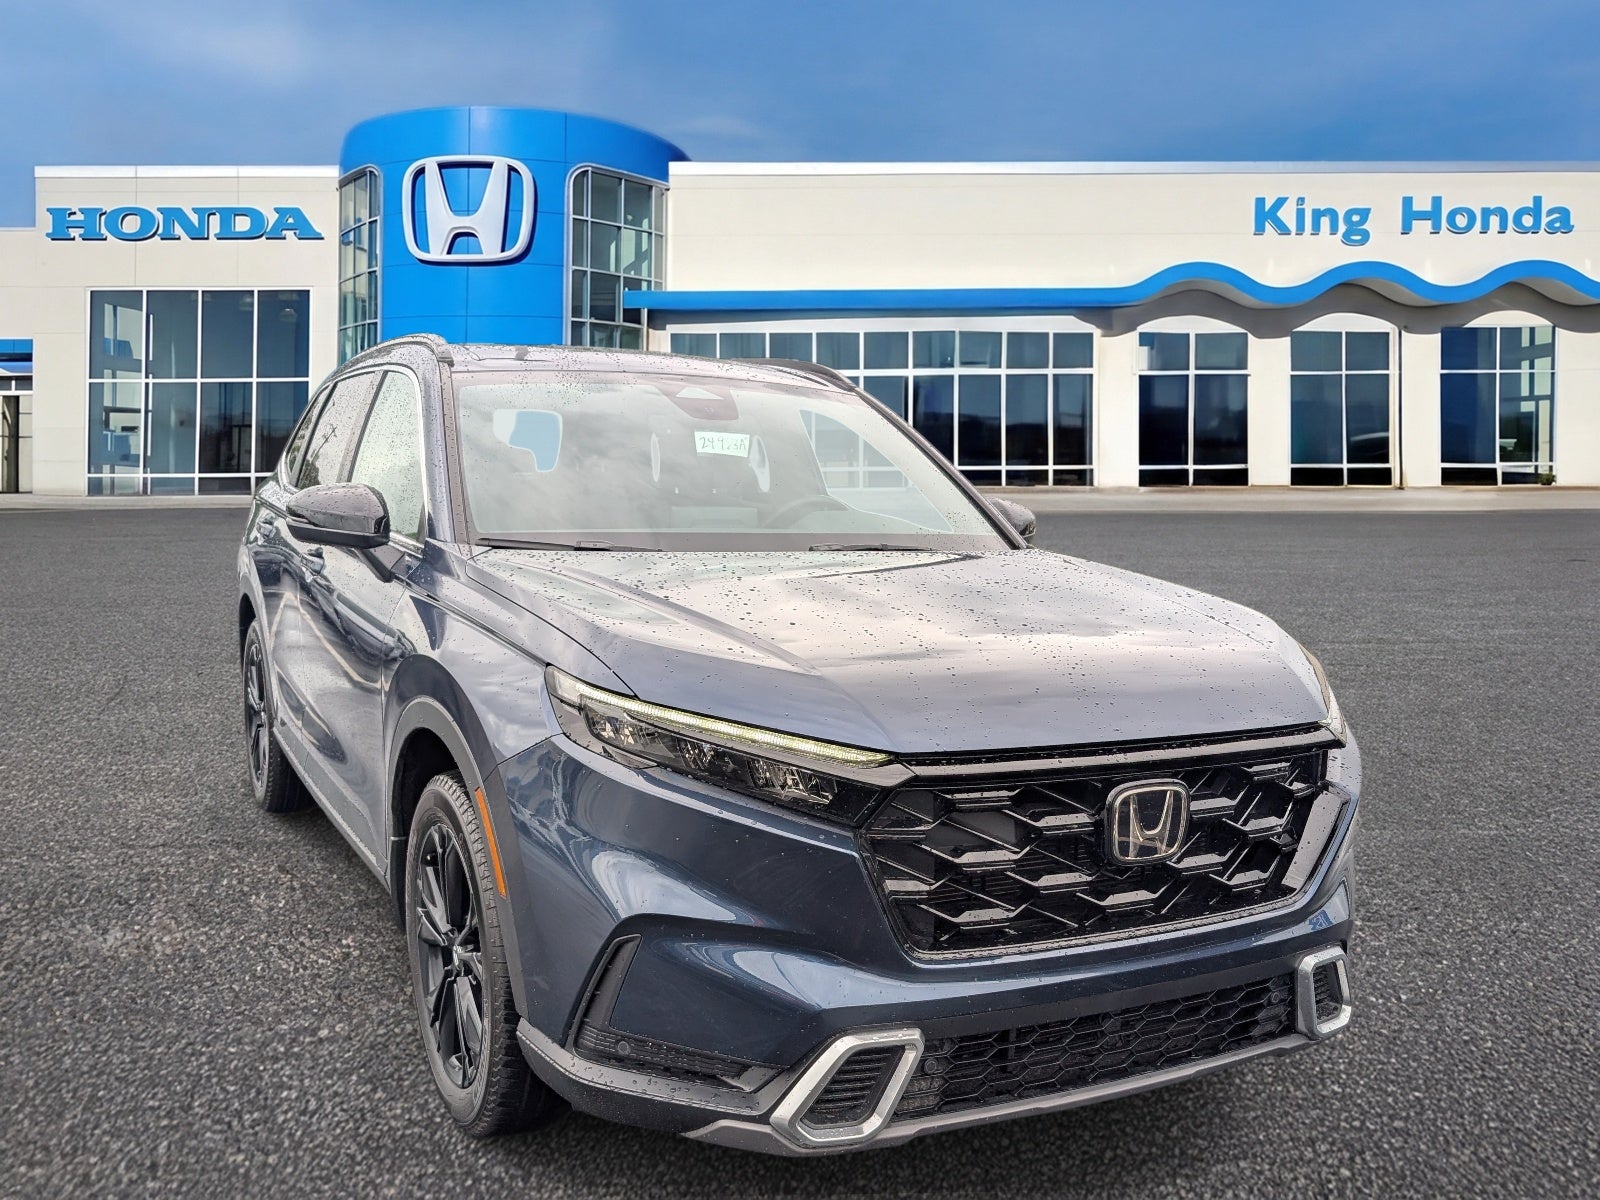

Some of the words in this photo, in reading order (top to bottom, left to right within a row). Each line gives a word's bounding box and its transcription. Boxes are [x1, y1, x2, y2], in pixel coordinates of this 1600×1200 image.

[46, 206, 325, 241] HONDA
[1254, 196, 1372, 246] King
[1400, 195, 1575, 235] Honda
